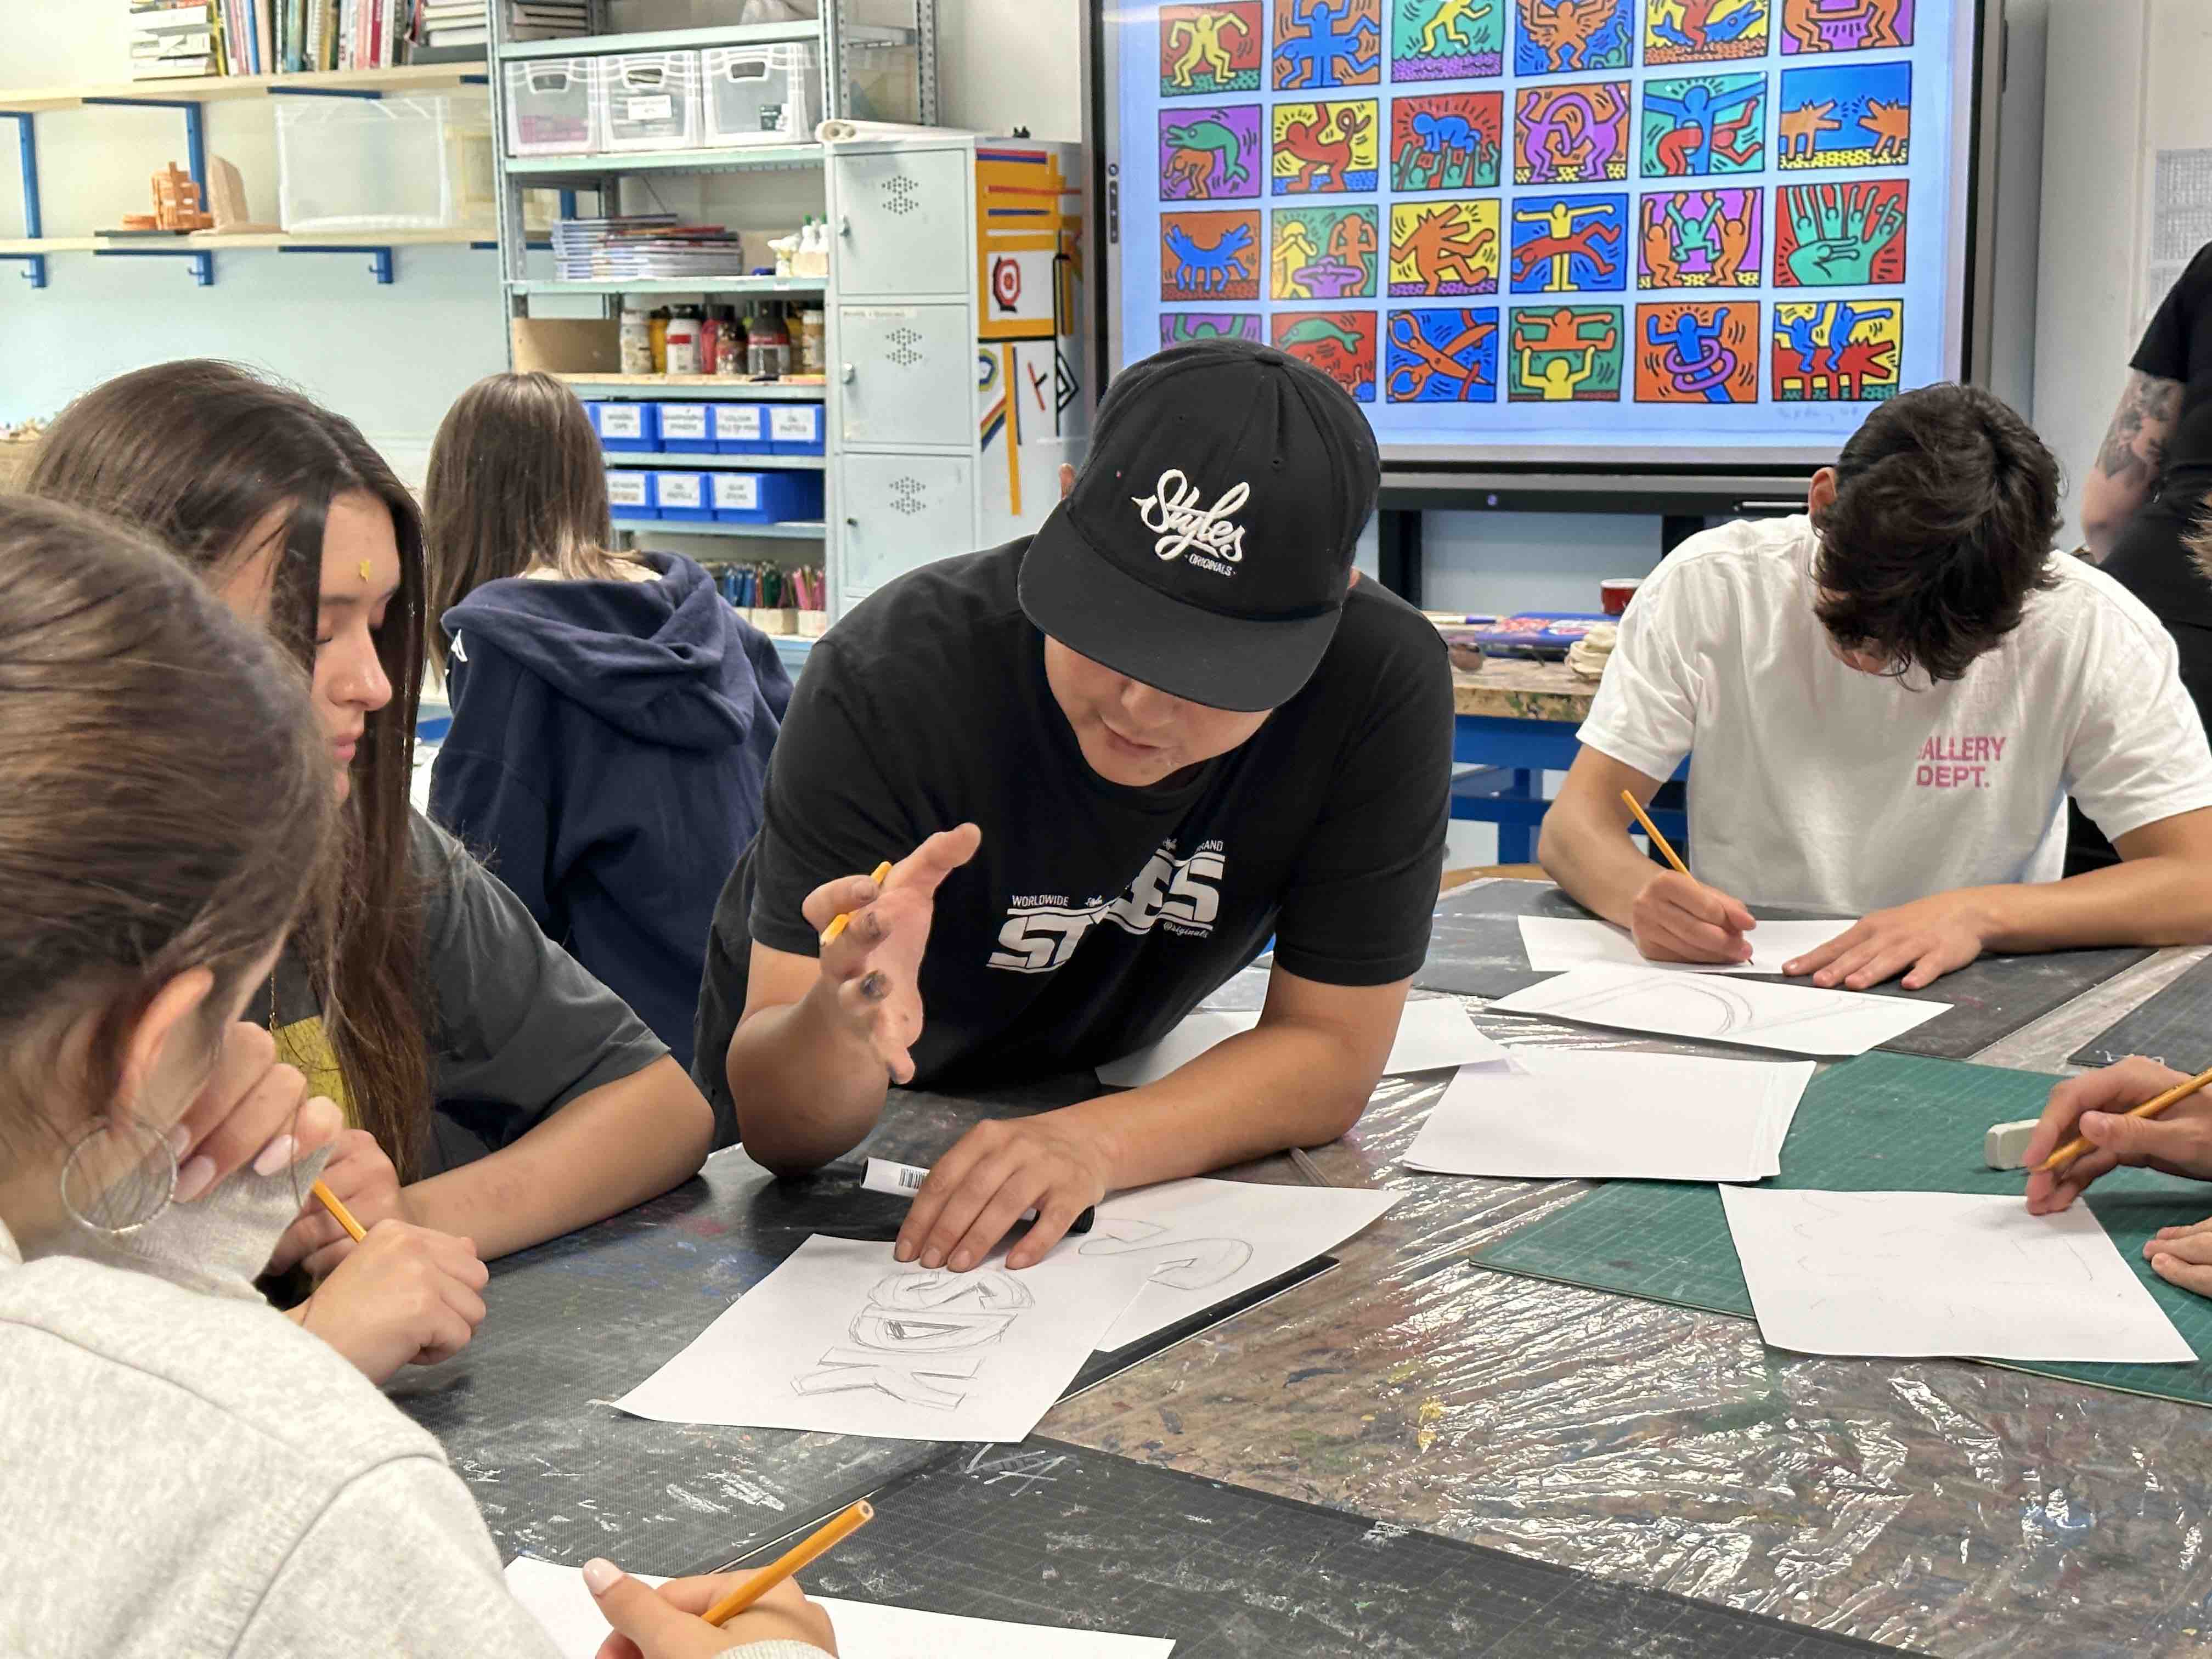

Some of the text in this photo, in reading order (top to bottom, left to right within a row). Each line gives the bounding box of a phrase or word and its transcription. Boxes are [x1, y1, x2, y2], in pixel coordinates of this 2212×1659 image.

[1131, 469, 1250, 562] Styles
[1188, 553, 1233, 577] ORIGINALS
[1917, 737, 2006, 761] ALLERY
[1916, 765, 1990, 788] DEPT.
[1012, 894, 1070, 907] WORLDWIDE
